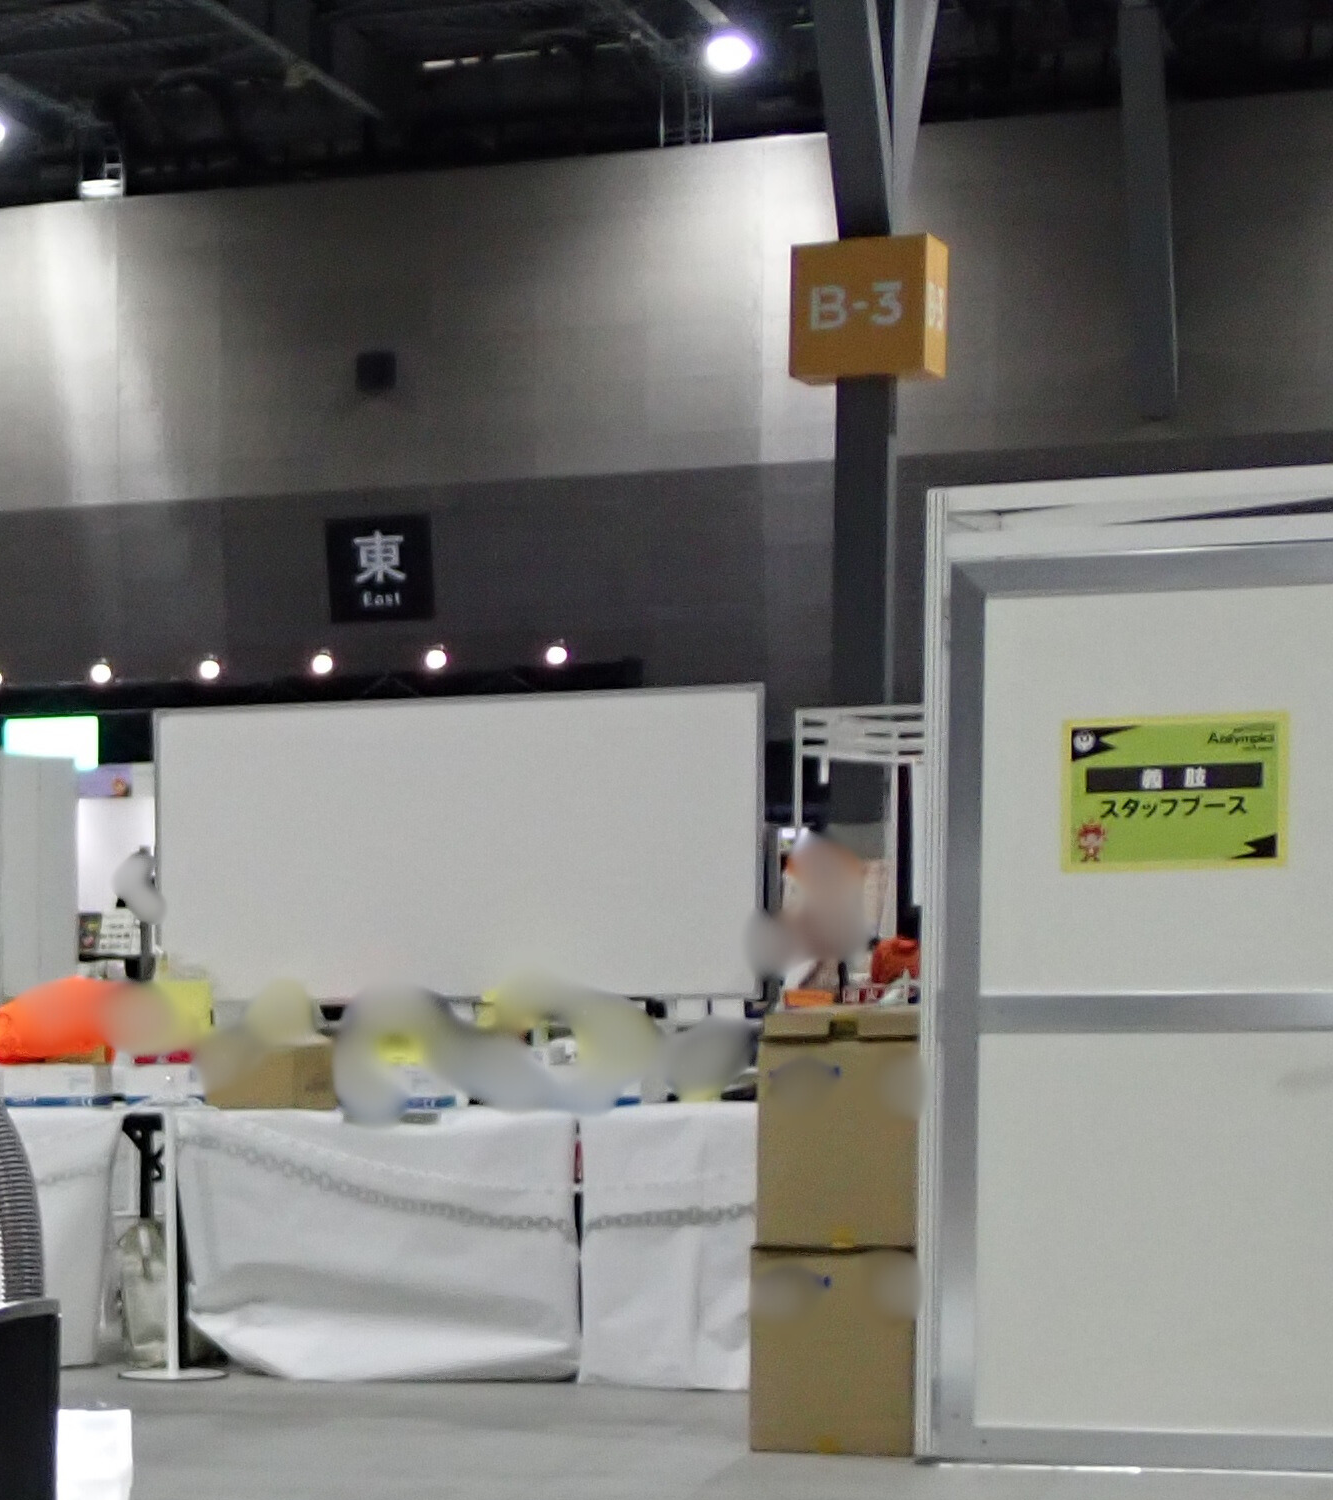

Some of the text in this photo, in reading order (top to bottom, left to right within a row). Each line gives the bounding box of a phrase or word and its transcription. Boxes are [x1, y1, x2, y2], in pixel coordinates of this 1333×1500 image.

[808, 280, 903, 331] B-3
[352, 530, 407, 584] 東
[1099, 795, 1248, 819] スタッフブース
